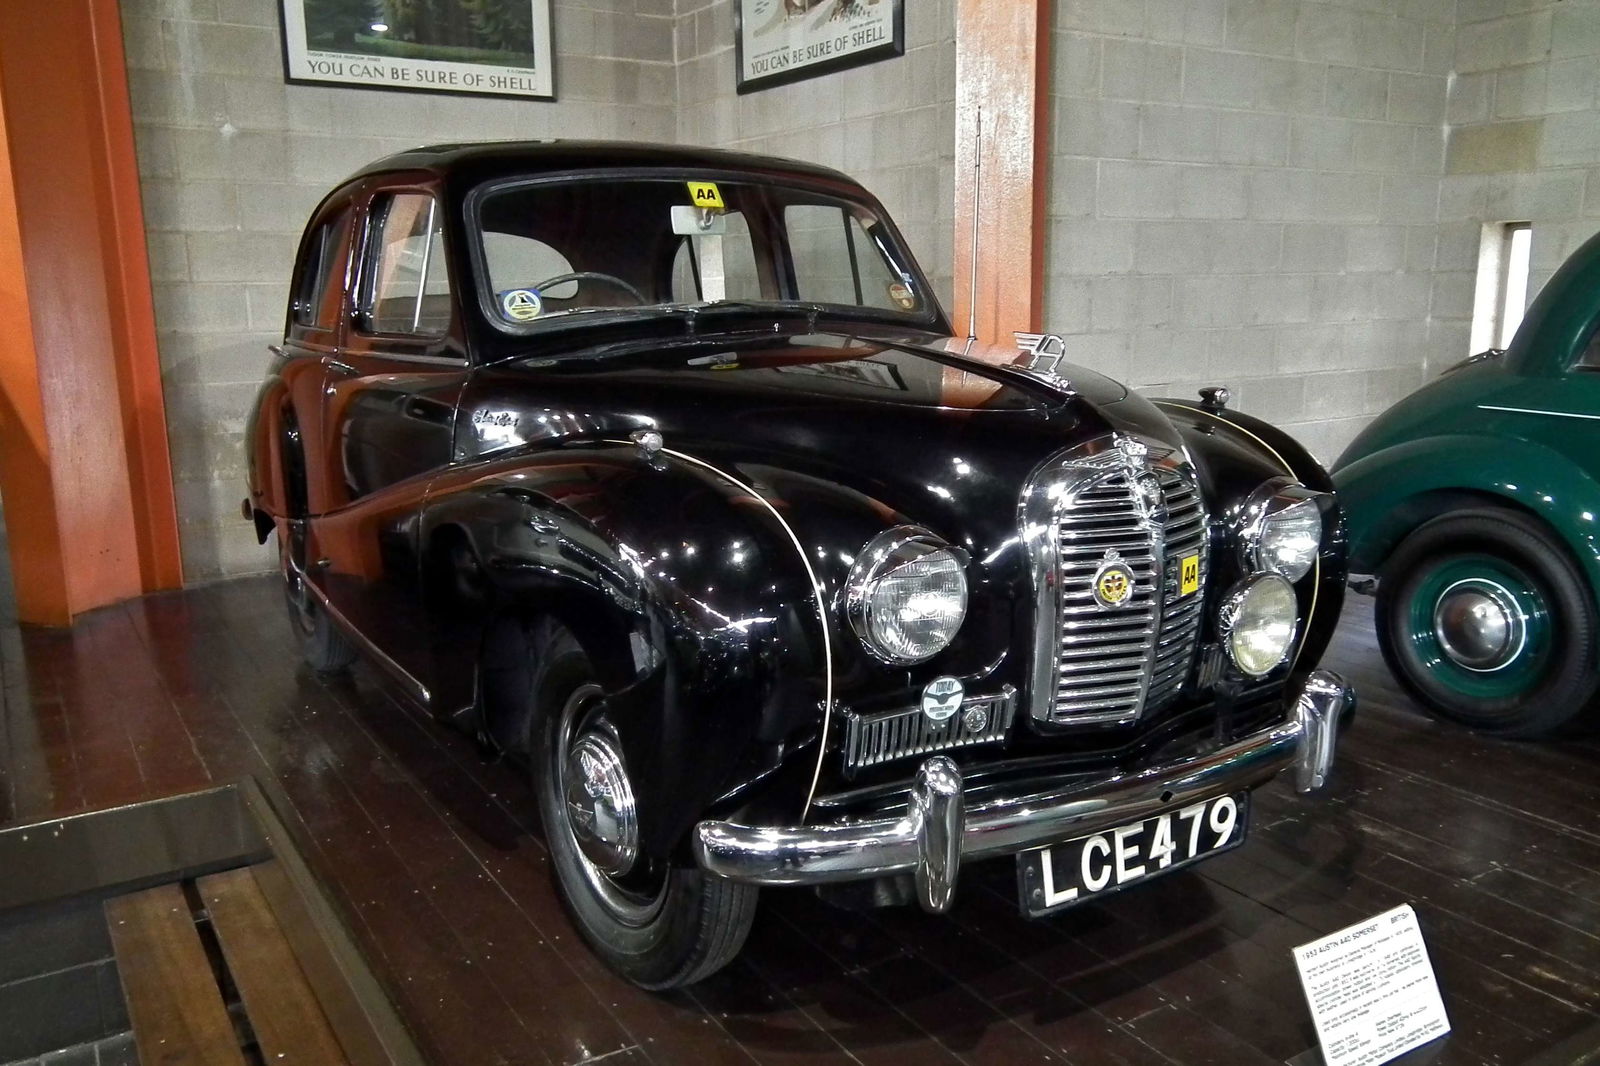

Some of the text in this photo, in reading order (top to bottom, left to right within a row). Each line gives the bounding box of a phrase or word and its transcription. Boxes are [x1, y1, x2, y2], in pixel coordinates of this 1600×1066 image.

[751, 59, 769, 75] YOU
[770, 54, 790, 70] CAN
[792, 48, 804, 64] BE
[806, 41, 832, 59] SURE
[834, 35, 849, 52] OF
[852, 26, 886, 47] SHELL
[306, 60, 536, 91] YOU CAN BE SURE OF SHELL
[696, 188, 716, 200] AA
[1183, 564, 1196, 585] AA
[1040, 796, 1238, 908] LCE479
[1318, 941, 1339, 954] AUSTIN
[1340, 935, 1352, 945] A40
[1352, 923, 1378, 940] SOMERSET
